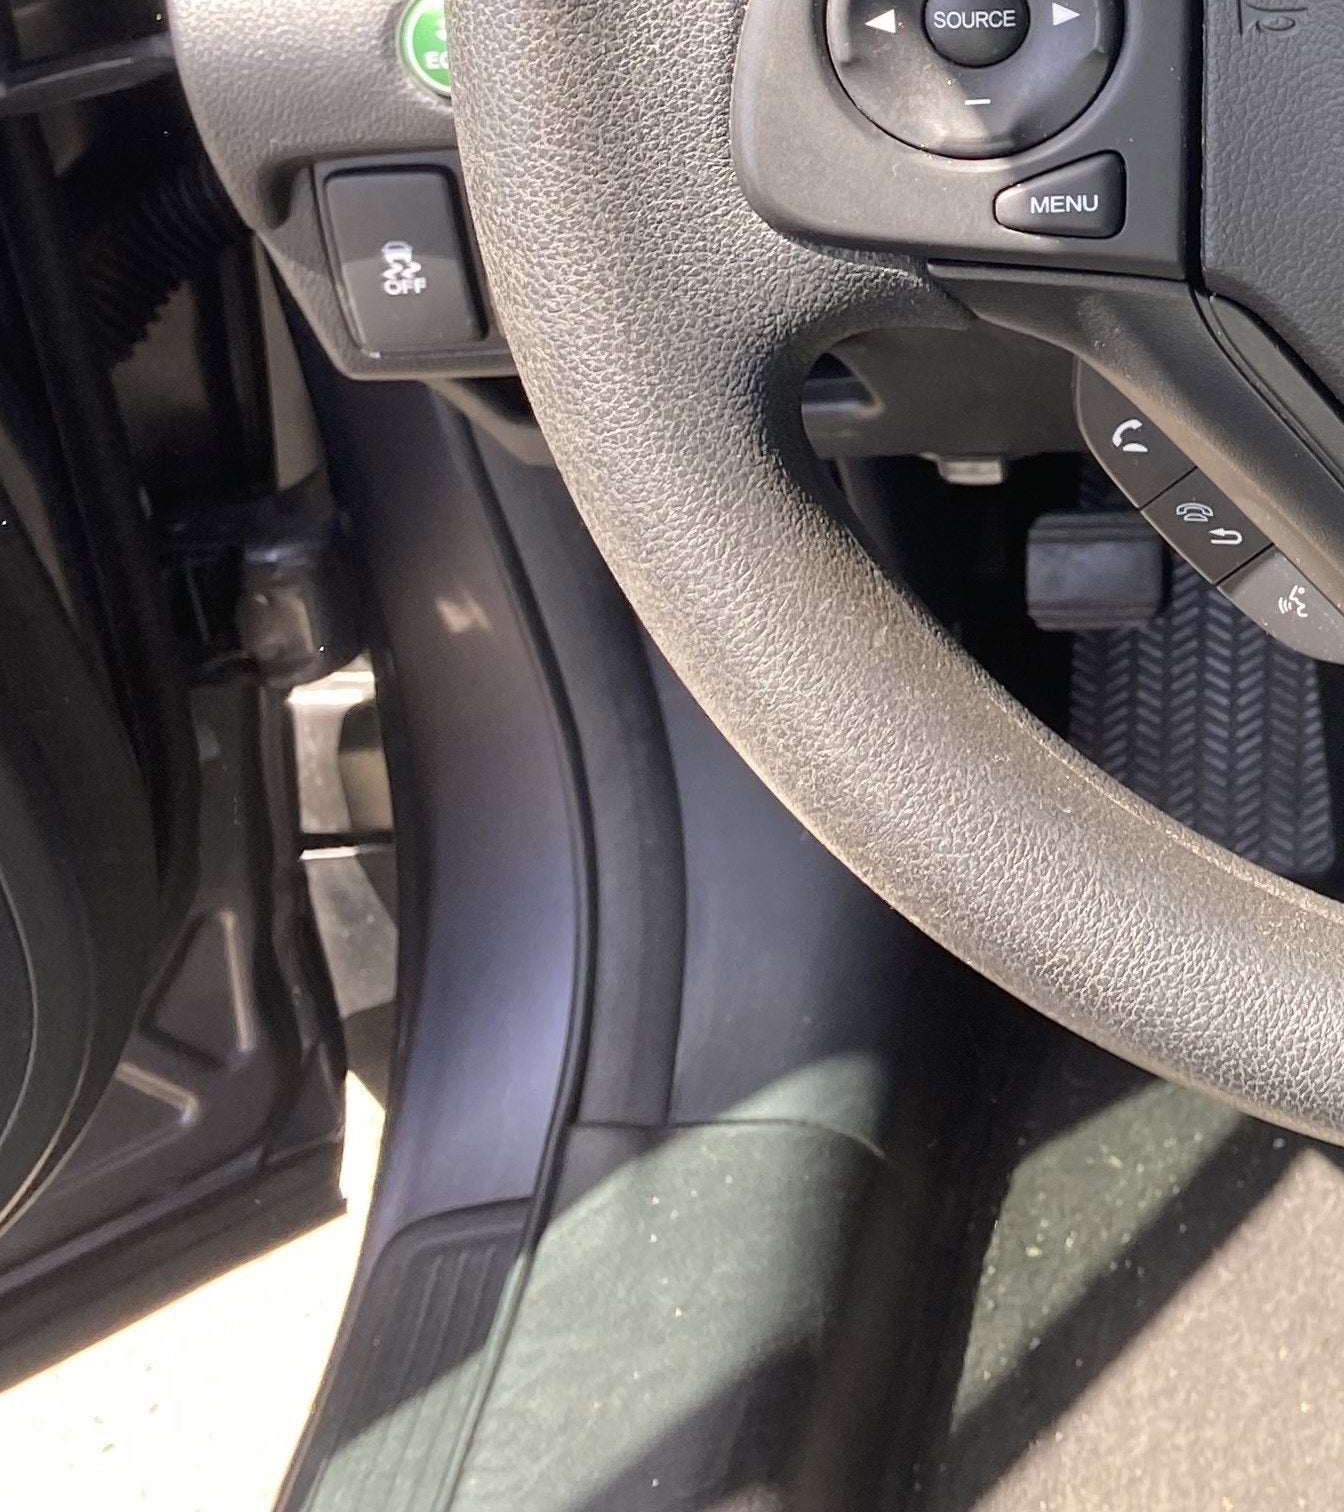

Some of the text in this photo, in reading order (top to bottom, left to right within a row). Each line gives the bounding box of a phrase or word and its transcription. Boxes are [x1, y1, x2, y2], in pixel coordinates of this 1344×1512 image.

[933, 9, 1017, 30] SOURCE
[424, 50, 449, 70] EC
[1029, 195, 1099, 215] MENU
[384, 277, 426, 296] OFF
